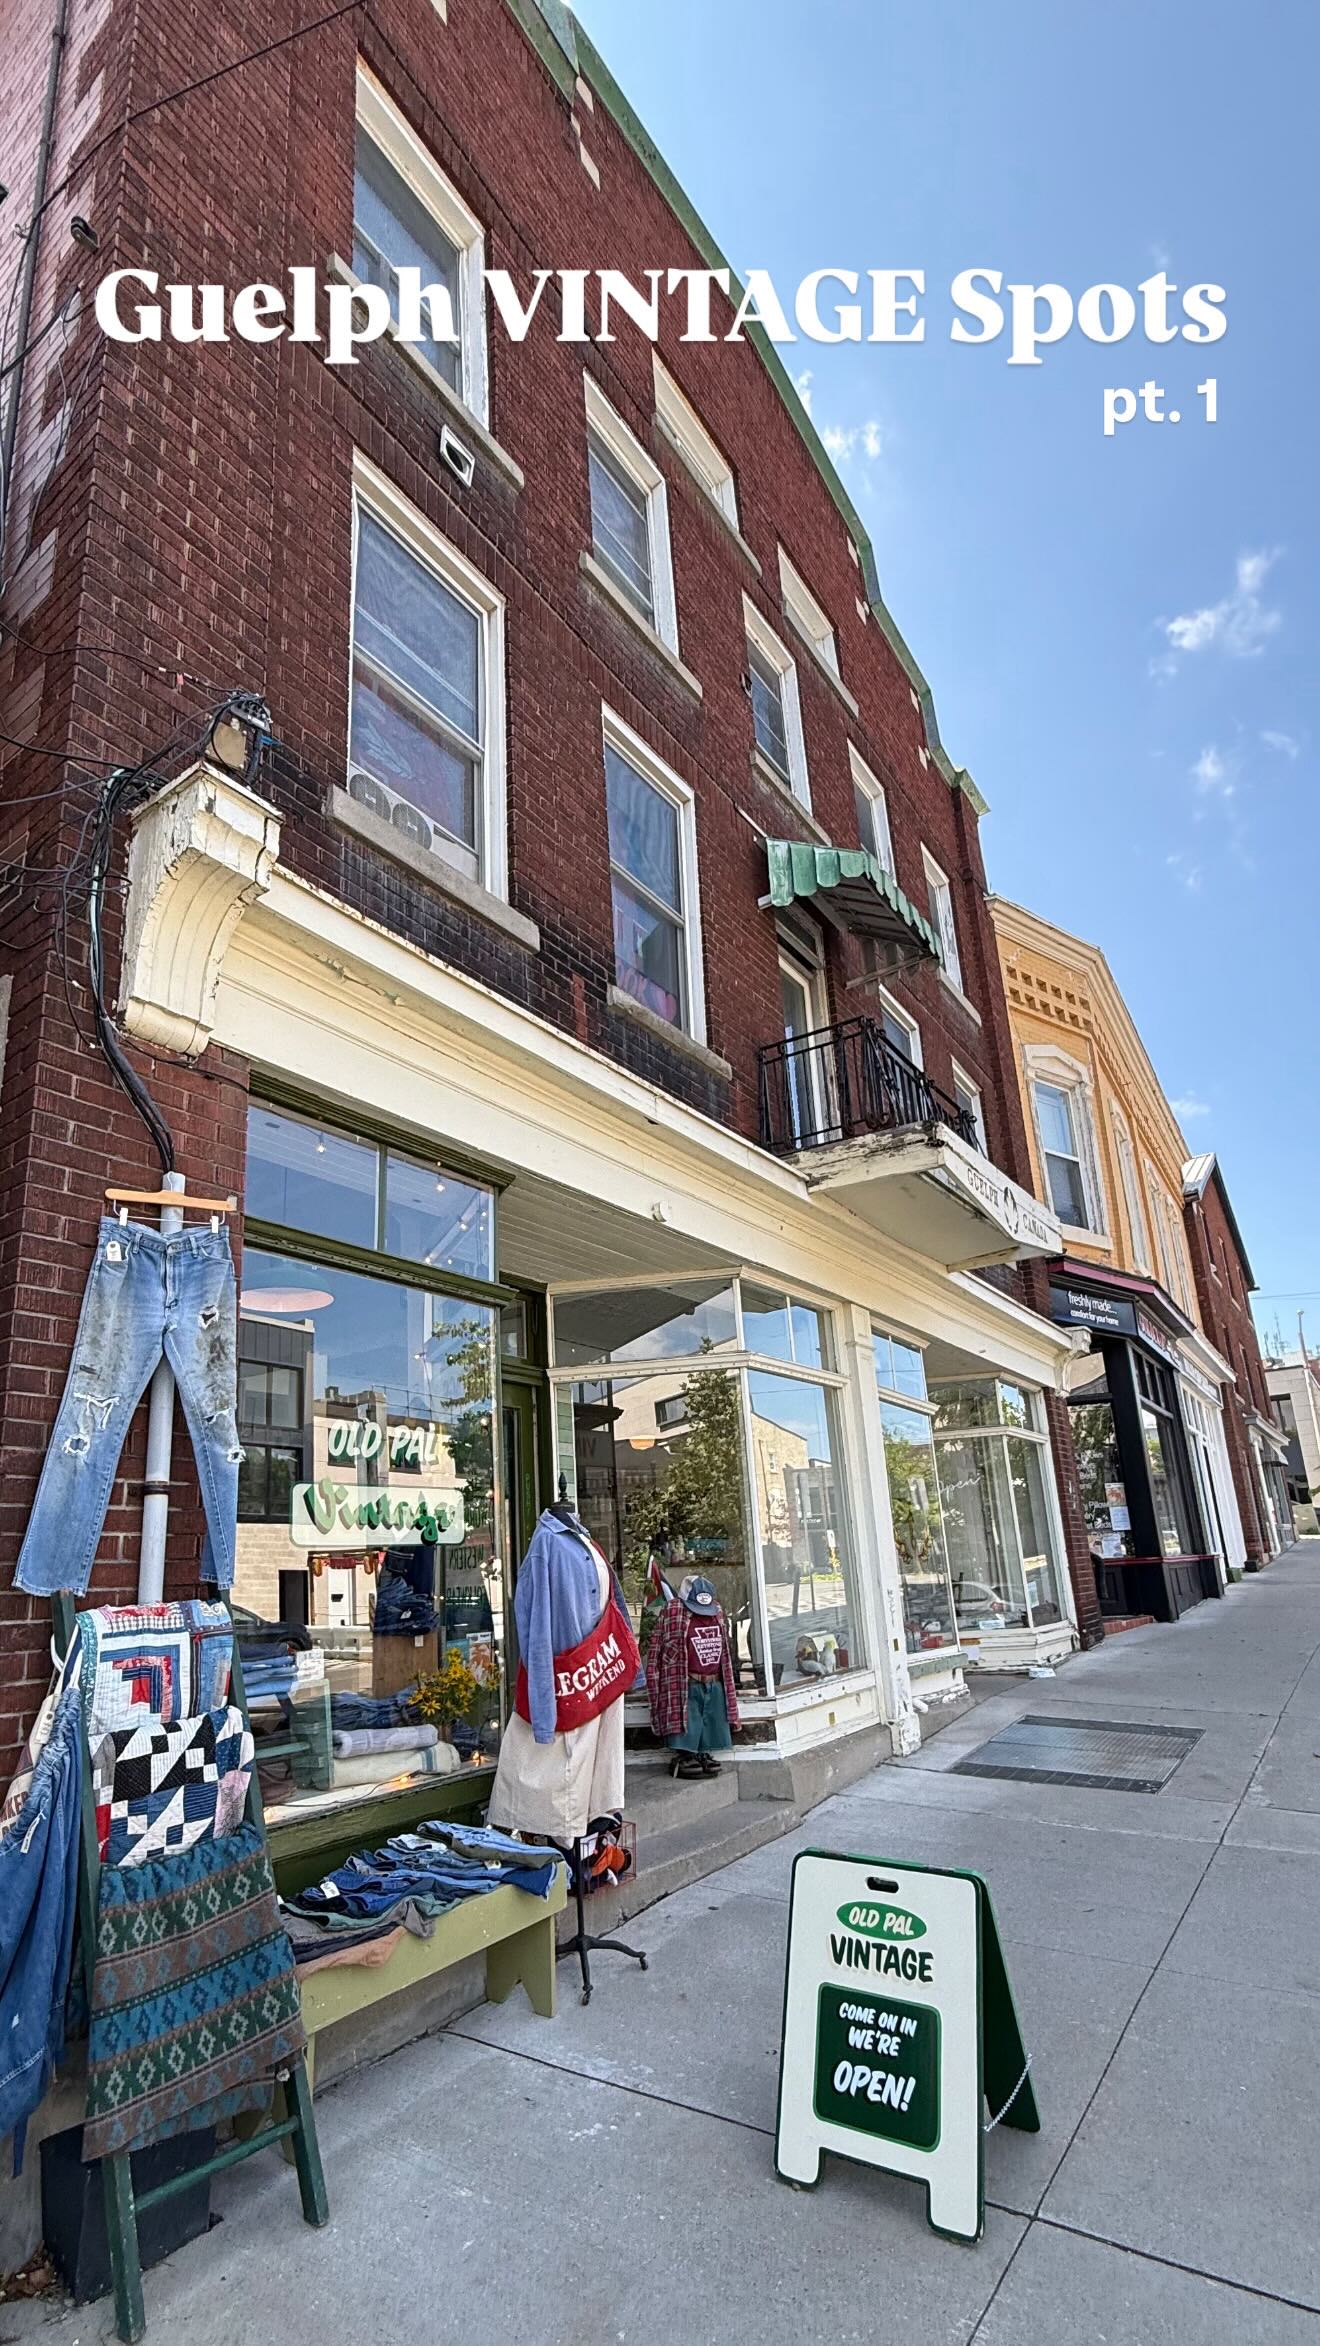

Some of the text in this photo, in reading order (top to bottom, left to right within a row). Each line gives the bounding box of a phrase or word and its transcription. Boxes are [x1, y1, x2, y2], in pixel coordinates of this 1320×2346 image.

[967, 1168, 1049, 1244] GUELPH CANADA
[1067, 1290, 1092, 1311] freshly
[1105, 1315, 1119, 1326] home
[327, 1421, 437, 1466] OLD PAL
[302, 1478, 455, 1545] Vintage
[555, 1632, 622, 1697] EGRAM
[847, 1905, 915, 1937] OLD PAL
[830, 1932, 935, 1983] VINTAGE
[838, 2001, 918, 2038] COME ON IN
[847, 2025, 901, 2057] WE'RE
[832, 2059, 917, 2112] OPEN!
